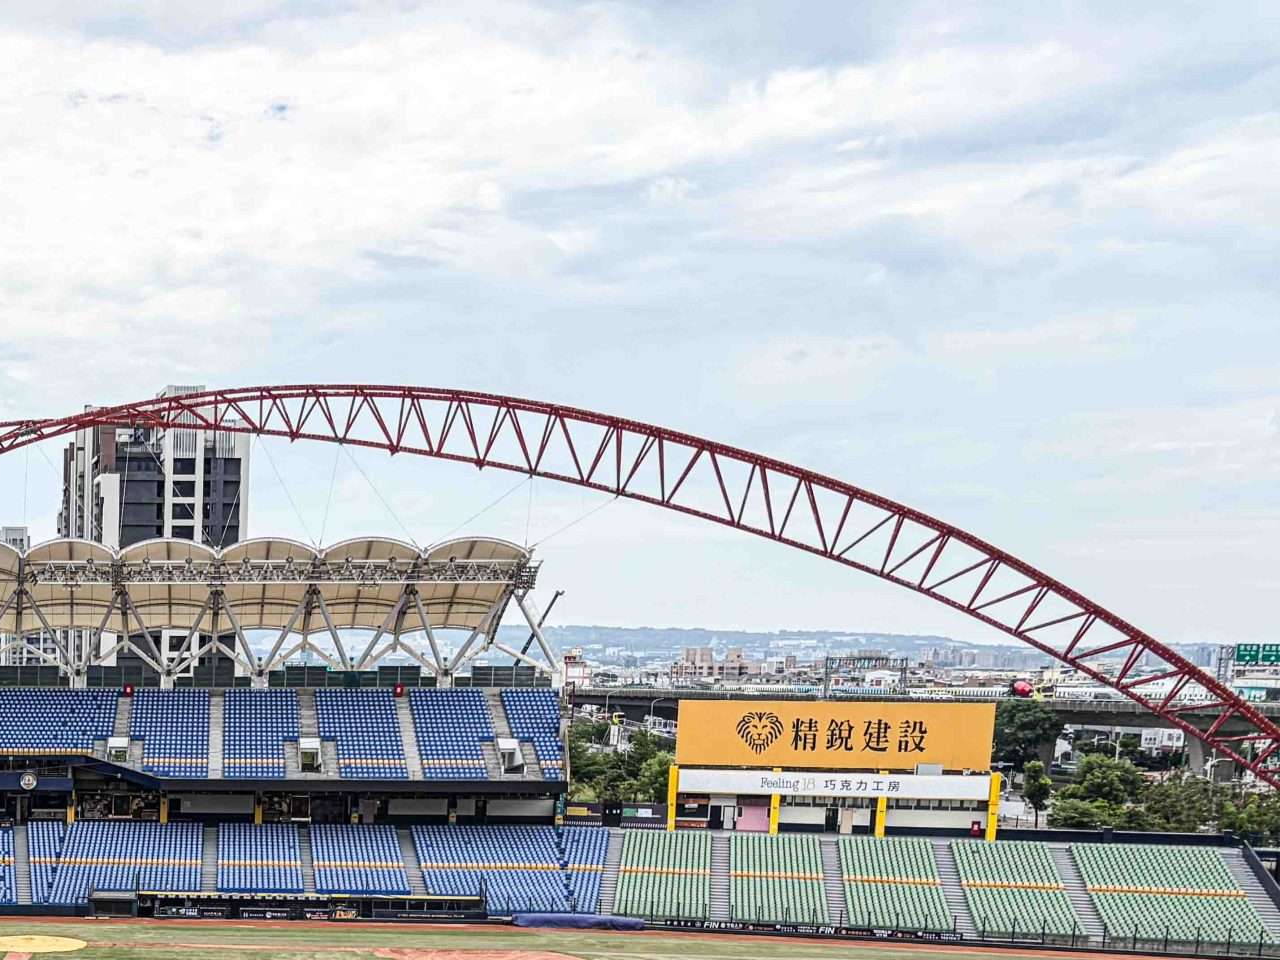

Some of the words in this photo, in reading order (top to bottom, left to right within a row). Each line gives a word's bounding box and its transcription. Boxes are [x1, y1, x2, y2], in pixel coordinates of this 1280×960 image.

[791, 718, 928, 753] 精銳建設
[760, 777, 800, 792] Feeling
[801, 777, 816, 791] 18
[823, 779, 900, 792] 巧克力工房
[703, 921, 720, 929] FIN
[818, 926, 836, 935] FIN
